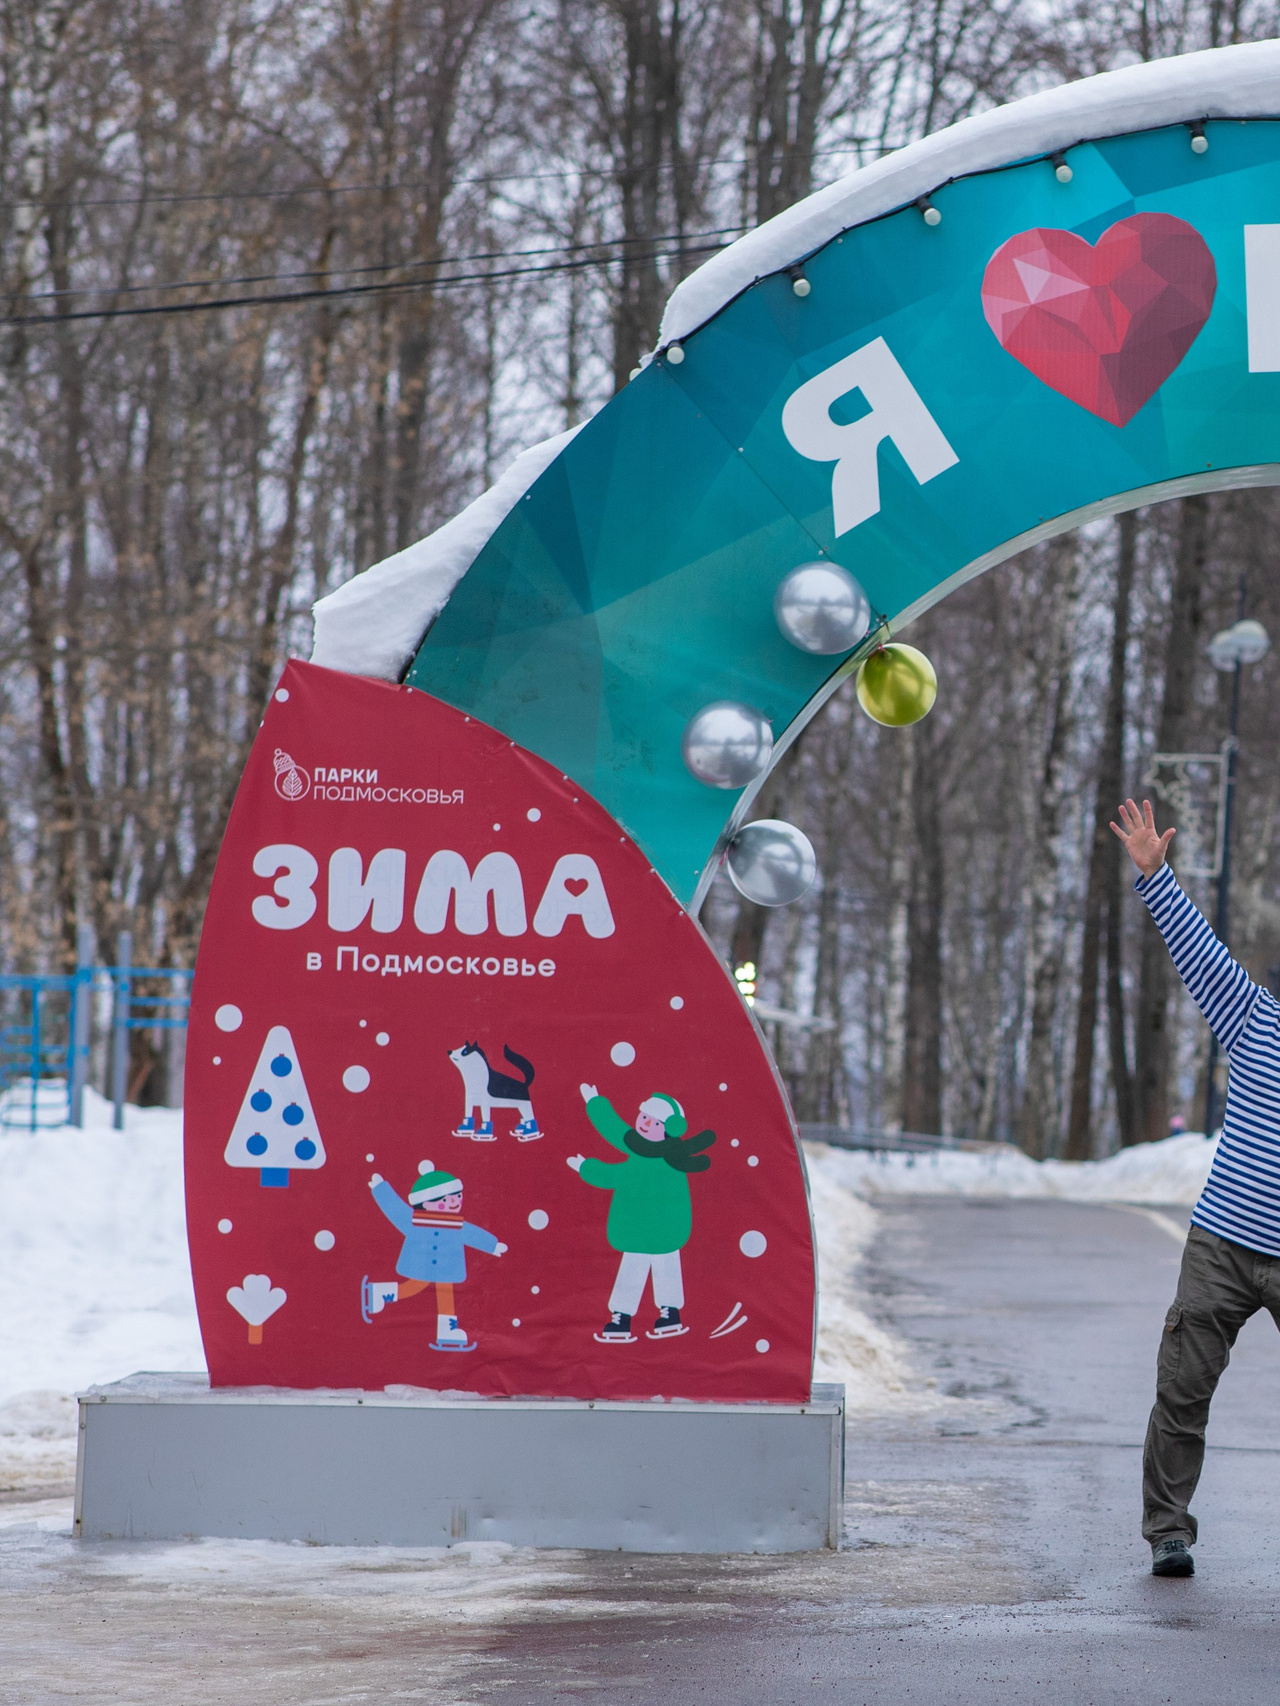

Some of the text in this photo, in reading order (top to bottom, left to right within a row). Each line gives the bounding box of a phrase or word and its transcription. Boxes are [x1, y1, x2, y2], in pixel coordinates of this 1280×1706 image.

[782, 336, 959, 538] Я
[314, 767, 378, 783] ПАРКИ
[313, 785, 464, 805] ПОДМОСКОВЬЯ
[251, 844, 616, 939] ЗИМА
[306, 945, 557, 977] в Подмосковье
